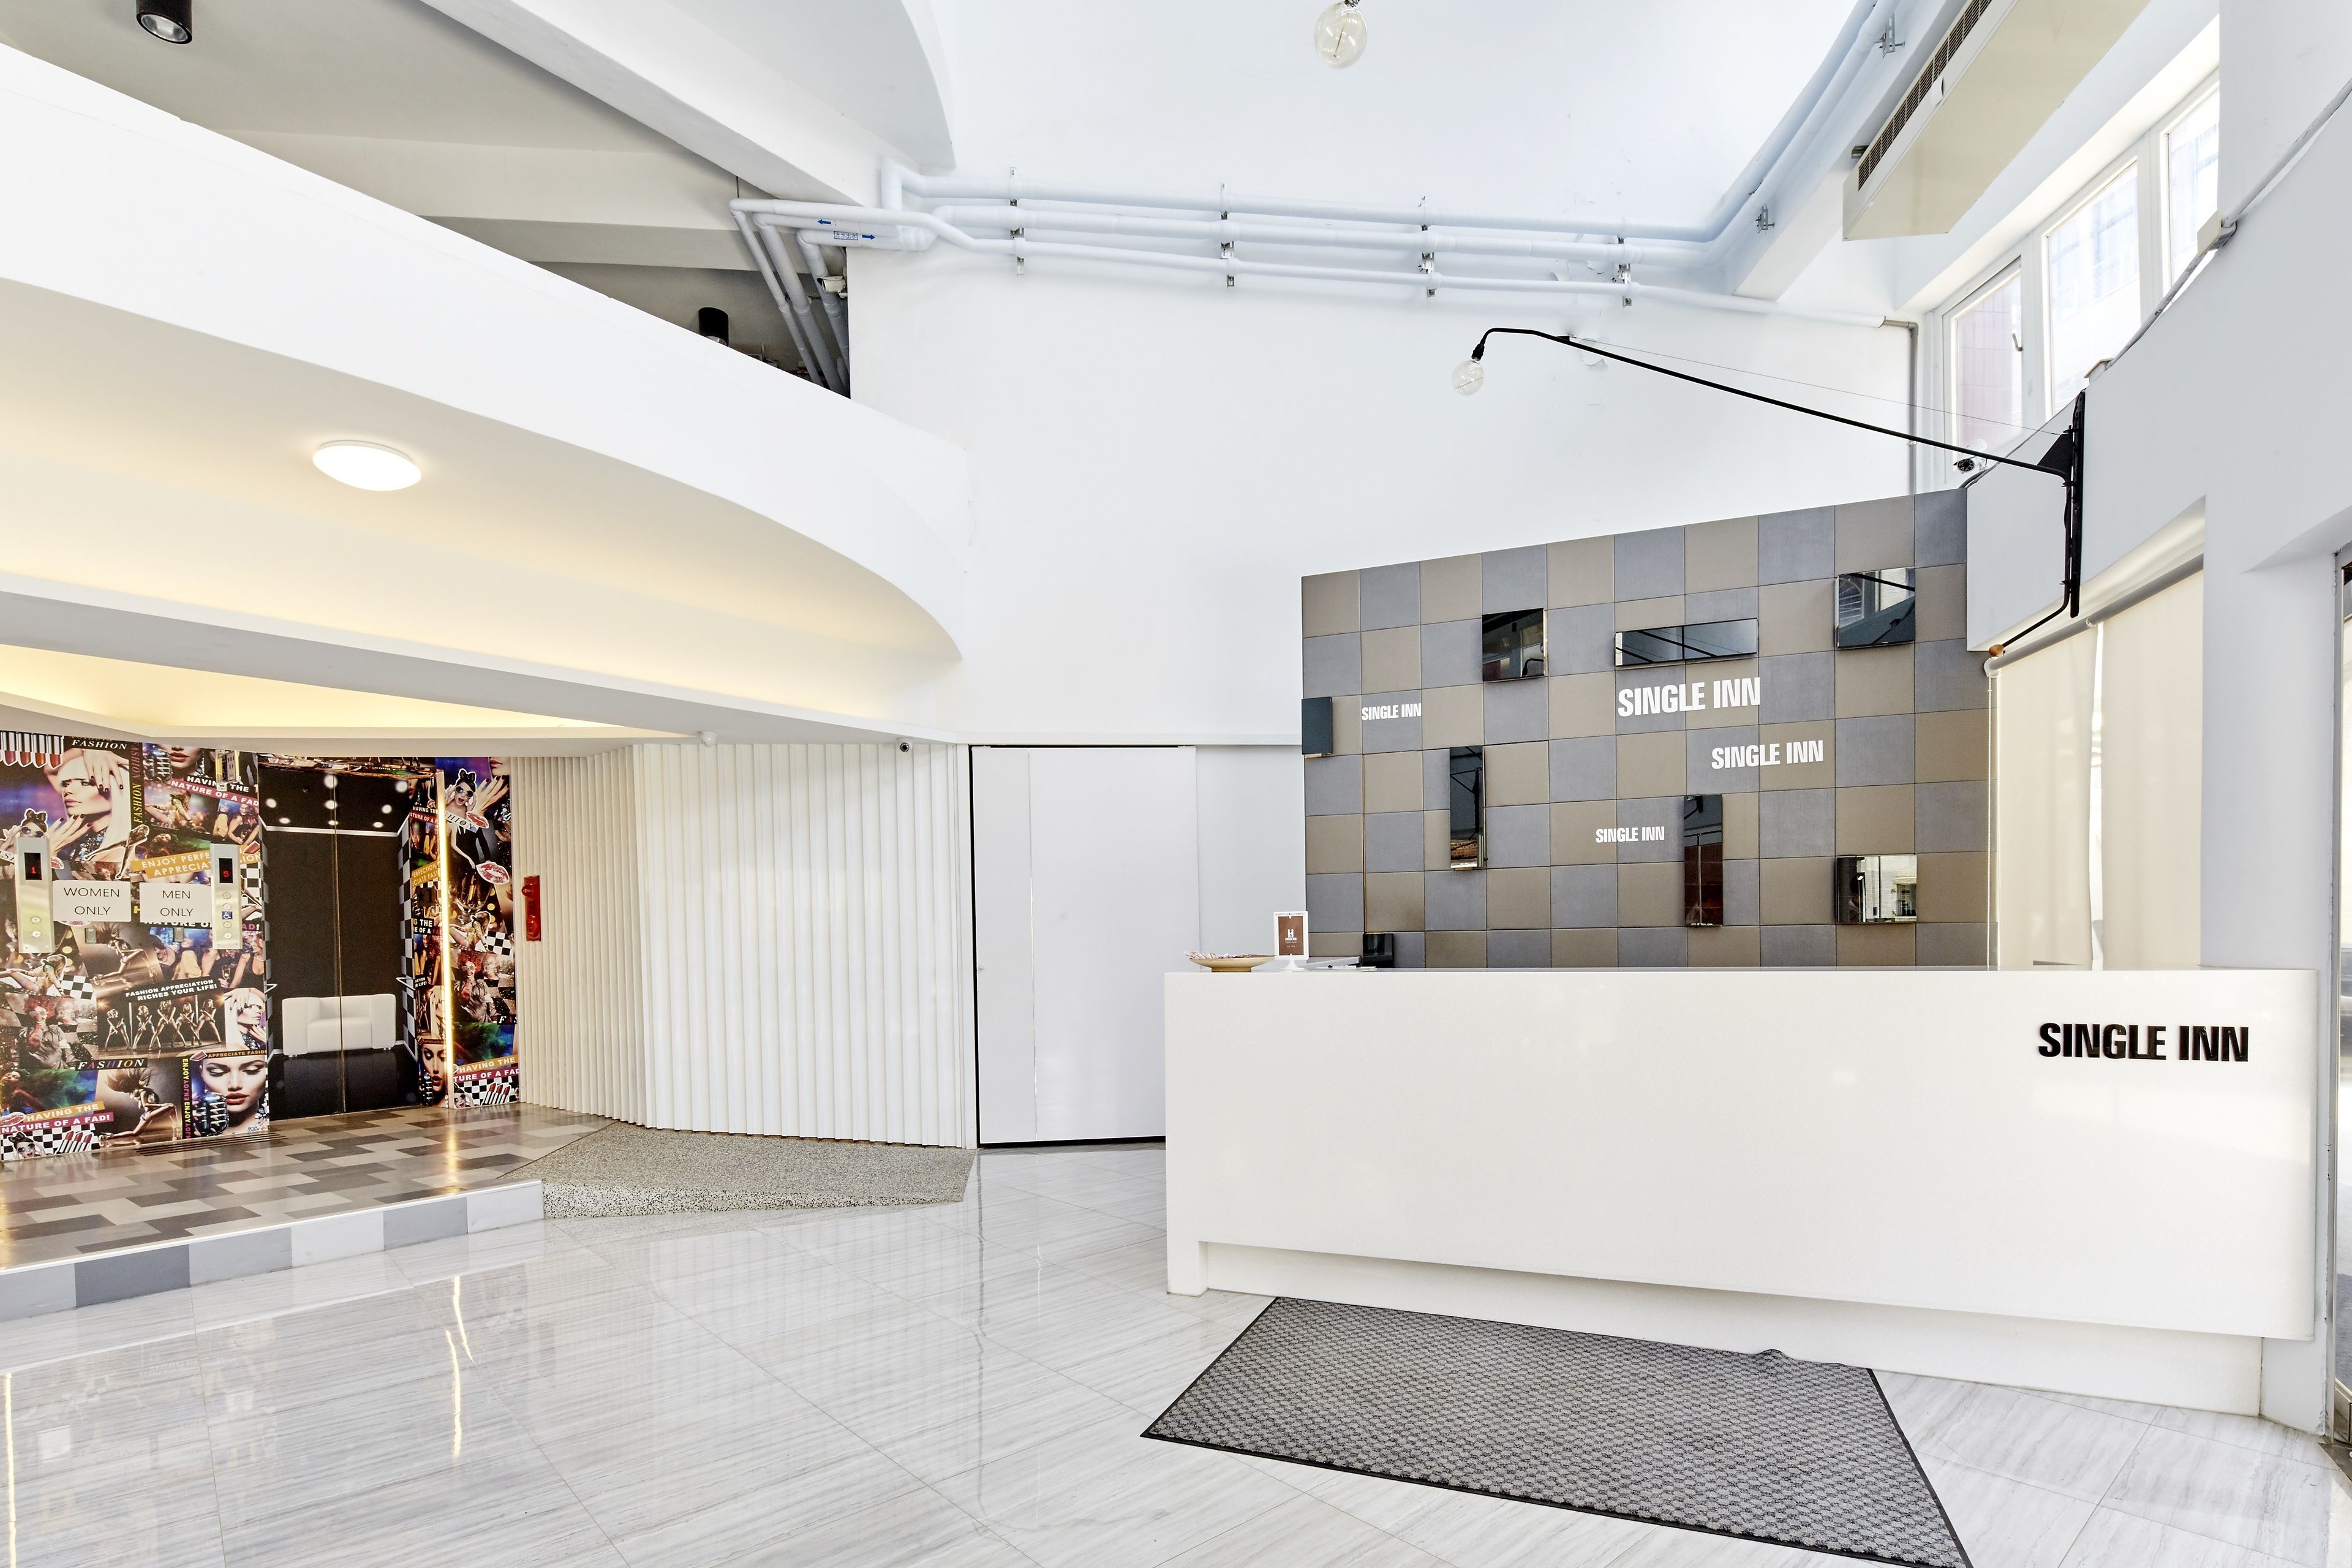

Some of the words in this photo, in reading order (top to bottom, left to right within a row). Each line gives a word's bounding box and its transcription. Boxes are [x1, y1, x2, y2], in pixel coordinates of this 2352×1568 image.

[1618, 682, 1706, 717] SINGLE
[1713, 677, 1760, 709] INN
[1361, 704, 1399, 721] SINGLE
[1401, 703, 1422, 718] INN
[72, 739, 127, 750] FASHION
[1711, 743, 1781, 769] SINGLE
[1786, 739, 1823, 764] INN
[171, 780, 212, 795] NATURE
[187, 775, 217, 786] HAVIN
[230, 783, 249, 793] THE
[132, 783, 143, 823] FASHION
[1595, 827, 1639, 843] SINGLE
[1642, 826, 1665, 842] INN
[141, 858, 177, 869] ENJOY
[64, 887, 120, 897] WOMEN
[162, 890, 190, 899] MEN
[75, 906, 111, 916] ONLY
[160, 907, 194, 916] ONLY
[419, 919, 433, 927] THE
[125, 987, 159, 997] FASHION
[160, 979, 214, 992] APPRECIATION
[137, 991, 169, 1001] RICHES
[171, 987, 195, 995] YOUR
[2038, 1022, 2167, 1060] SINGLE
[2179, 1025, 2249, 1062] INN
[77, 1059, 145, 1071] FASHION
[459, 1061, 494, 1073] HAVING
[27, 1107, 73, 1122] HAVING
[76, 1103, 99, 1114] THE
[1, 1120, 50, 1134] NATURE
[55, 1118, 69, 1127] OF
[85, 1114, 110, 1123] FAD!
